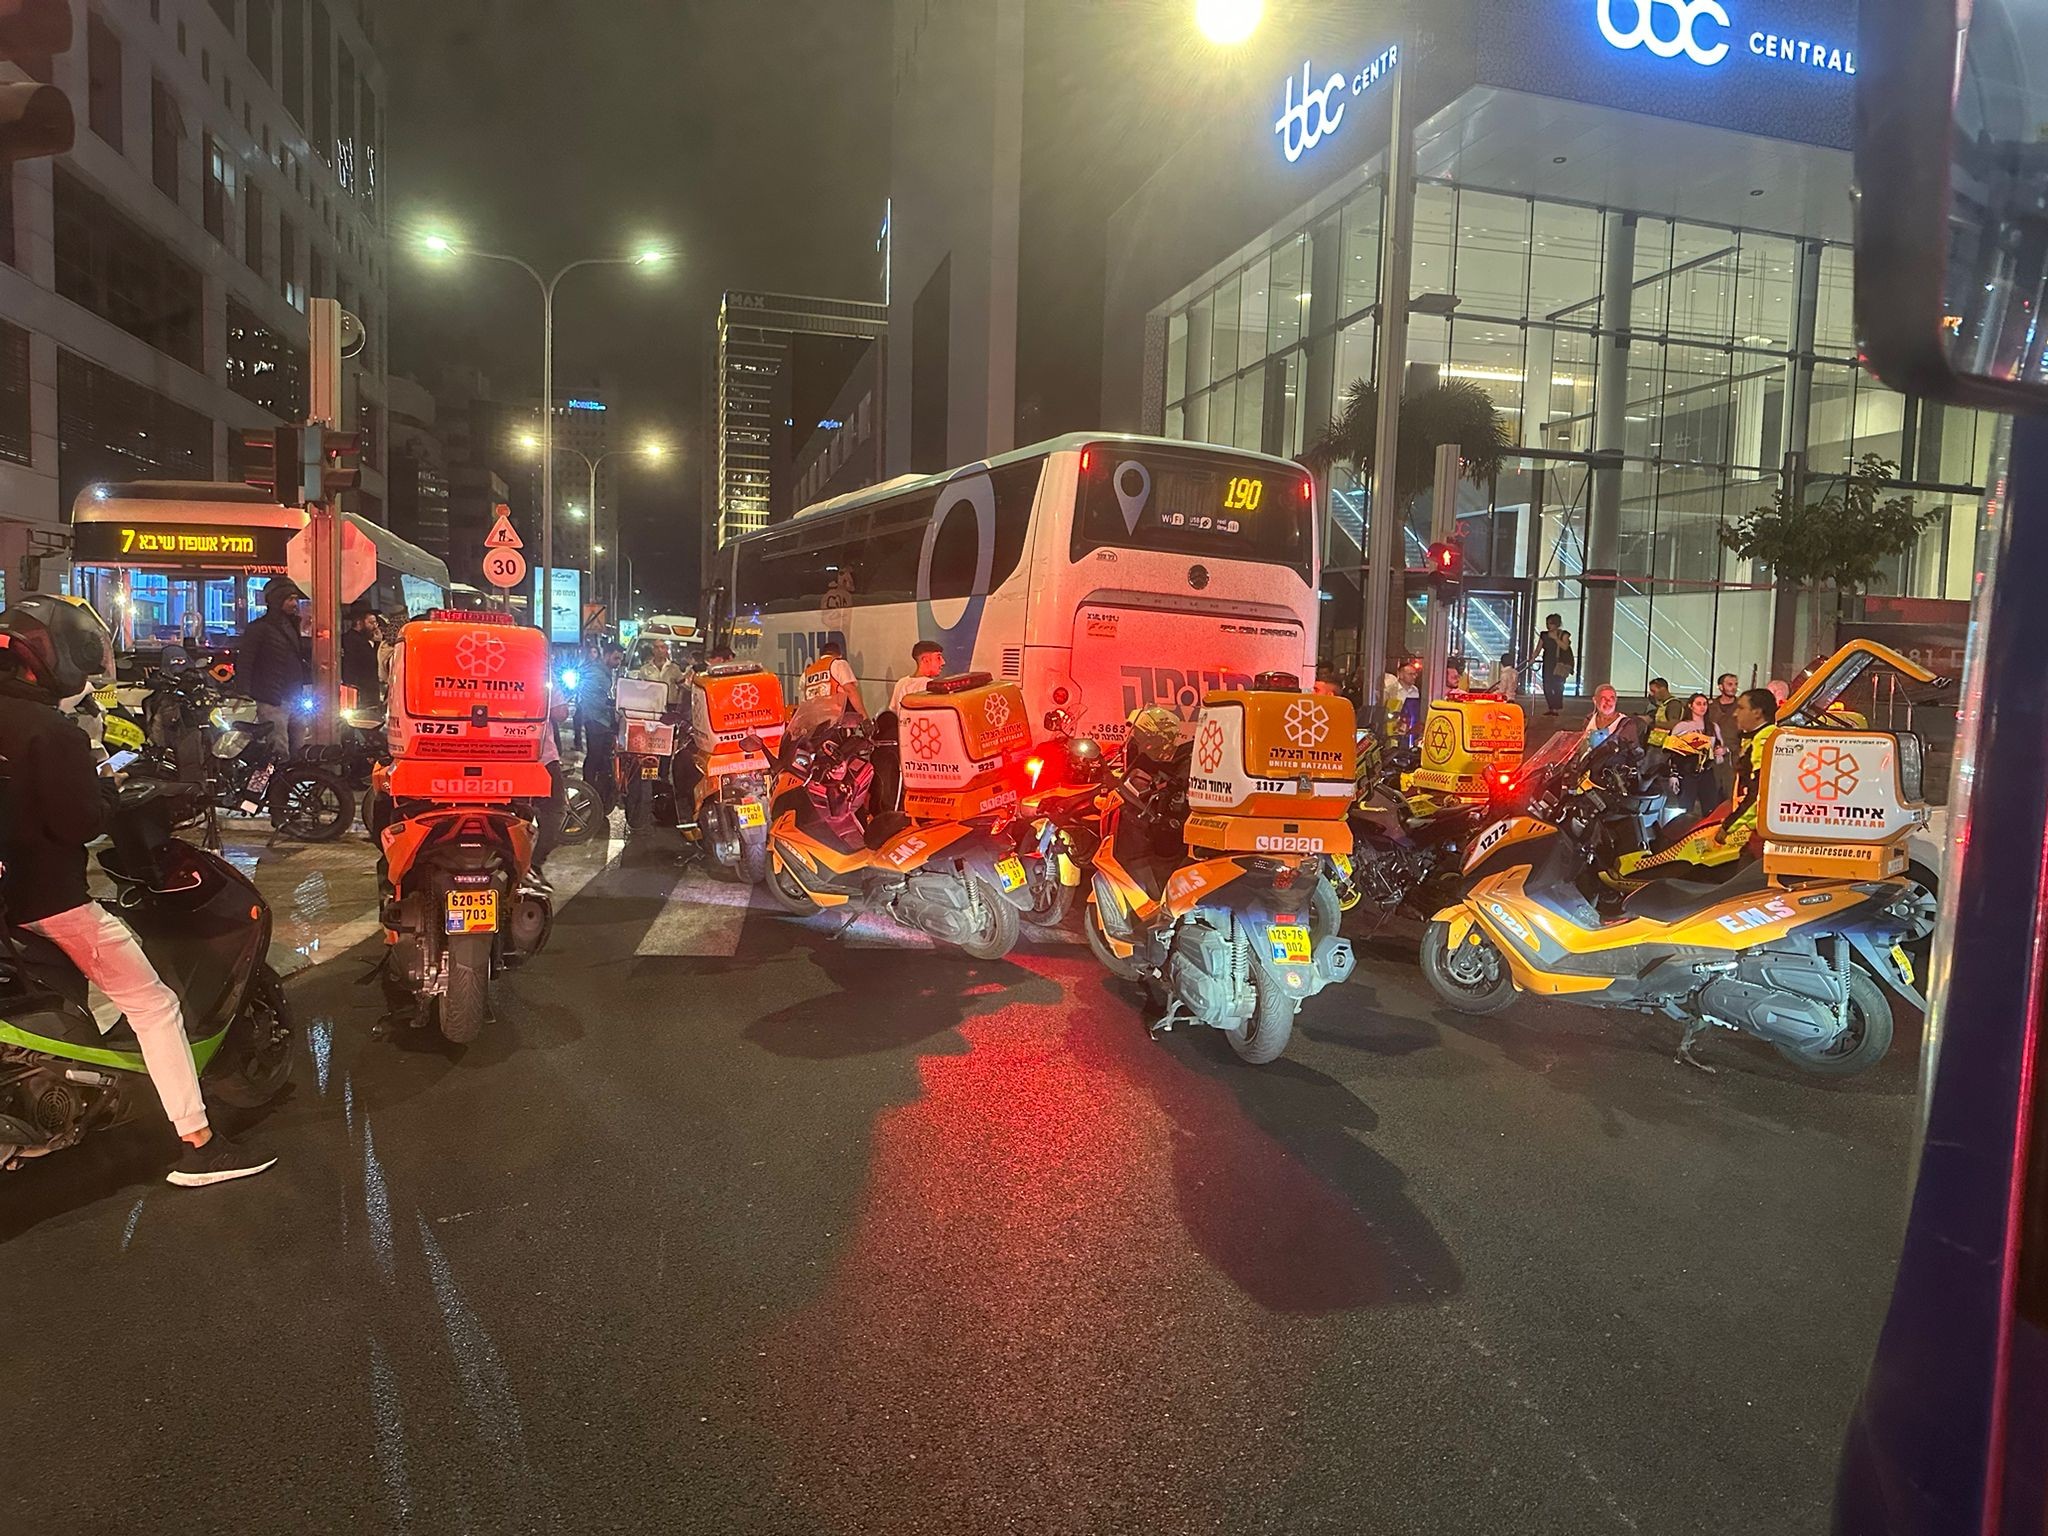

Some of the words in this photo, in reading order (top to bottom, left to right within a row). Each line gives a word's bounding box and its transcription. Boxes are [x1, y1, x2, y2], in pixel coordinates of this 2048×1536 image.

[1749, 31, 1856, 75] CENTRAL
[1351, 45, 1397, 96] CENTR
[730, 293, 765, 308] MAX
[1224, 477, 1262, 510] 190
[121, 529, 136, 553] 7
[139, 535, 175, 551] שיבא
[179, 536, 218, 552] אשפוז
[221, 536, 254, 552] מגדל
[493, 559, 516, 576] 30
[434, 677, 478, 690] הצלה
[808, 672, 829, 684] חובש
[482, 680, 525, 692] איחוד
[723, 711, 746, 721] הצלה
[748, 708, 772, 717] איחוד
[503, 726, 527, 736] הראל
[1001, 722, 1022, 735] איחוד
[719, 733, 744, 742] 1400
[980, 730, 1000, 741] הצלה
[1269, 747, 1304, 760] הצלה
[1308, 750, 1342, 762] איחוד
[1775, 745, 1794, 754] הראל
[905, 761, 929, 772] הצלה
[931, 763, 959, 773] איחוד
[1301, 762, 1343, 771] HATZALAH
[450, 780, 511, 793] 1221
[1208, 779, 1232, 794] איחוד
[1255, 781, 1285, 792] 1117
[1780, 802, 1828, 816] הצלה
[1833, 806, 1885, 820] איחוד
[1779, 815, 1821, 825] UNITED
[1824, 818, 1885, 829] HATZALAH
[1480, 823, 1510, 851] 1272
[888, 836, 927, 866] E.M.S
[1272, 838, 1321, 851] 1221
[1774, 844, 1873, 860] www.israelrescue.org
[452, 894, 493, 907] 620-55
[466, 909, 487, 921] 703
[1716, 899, 1797, 934] E.M.S
[1271, 929, 1304, 940] 129-76
[1286, 942, 1304, 952] 002
